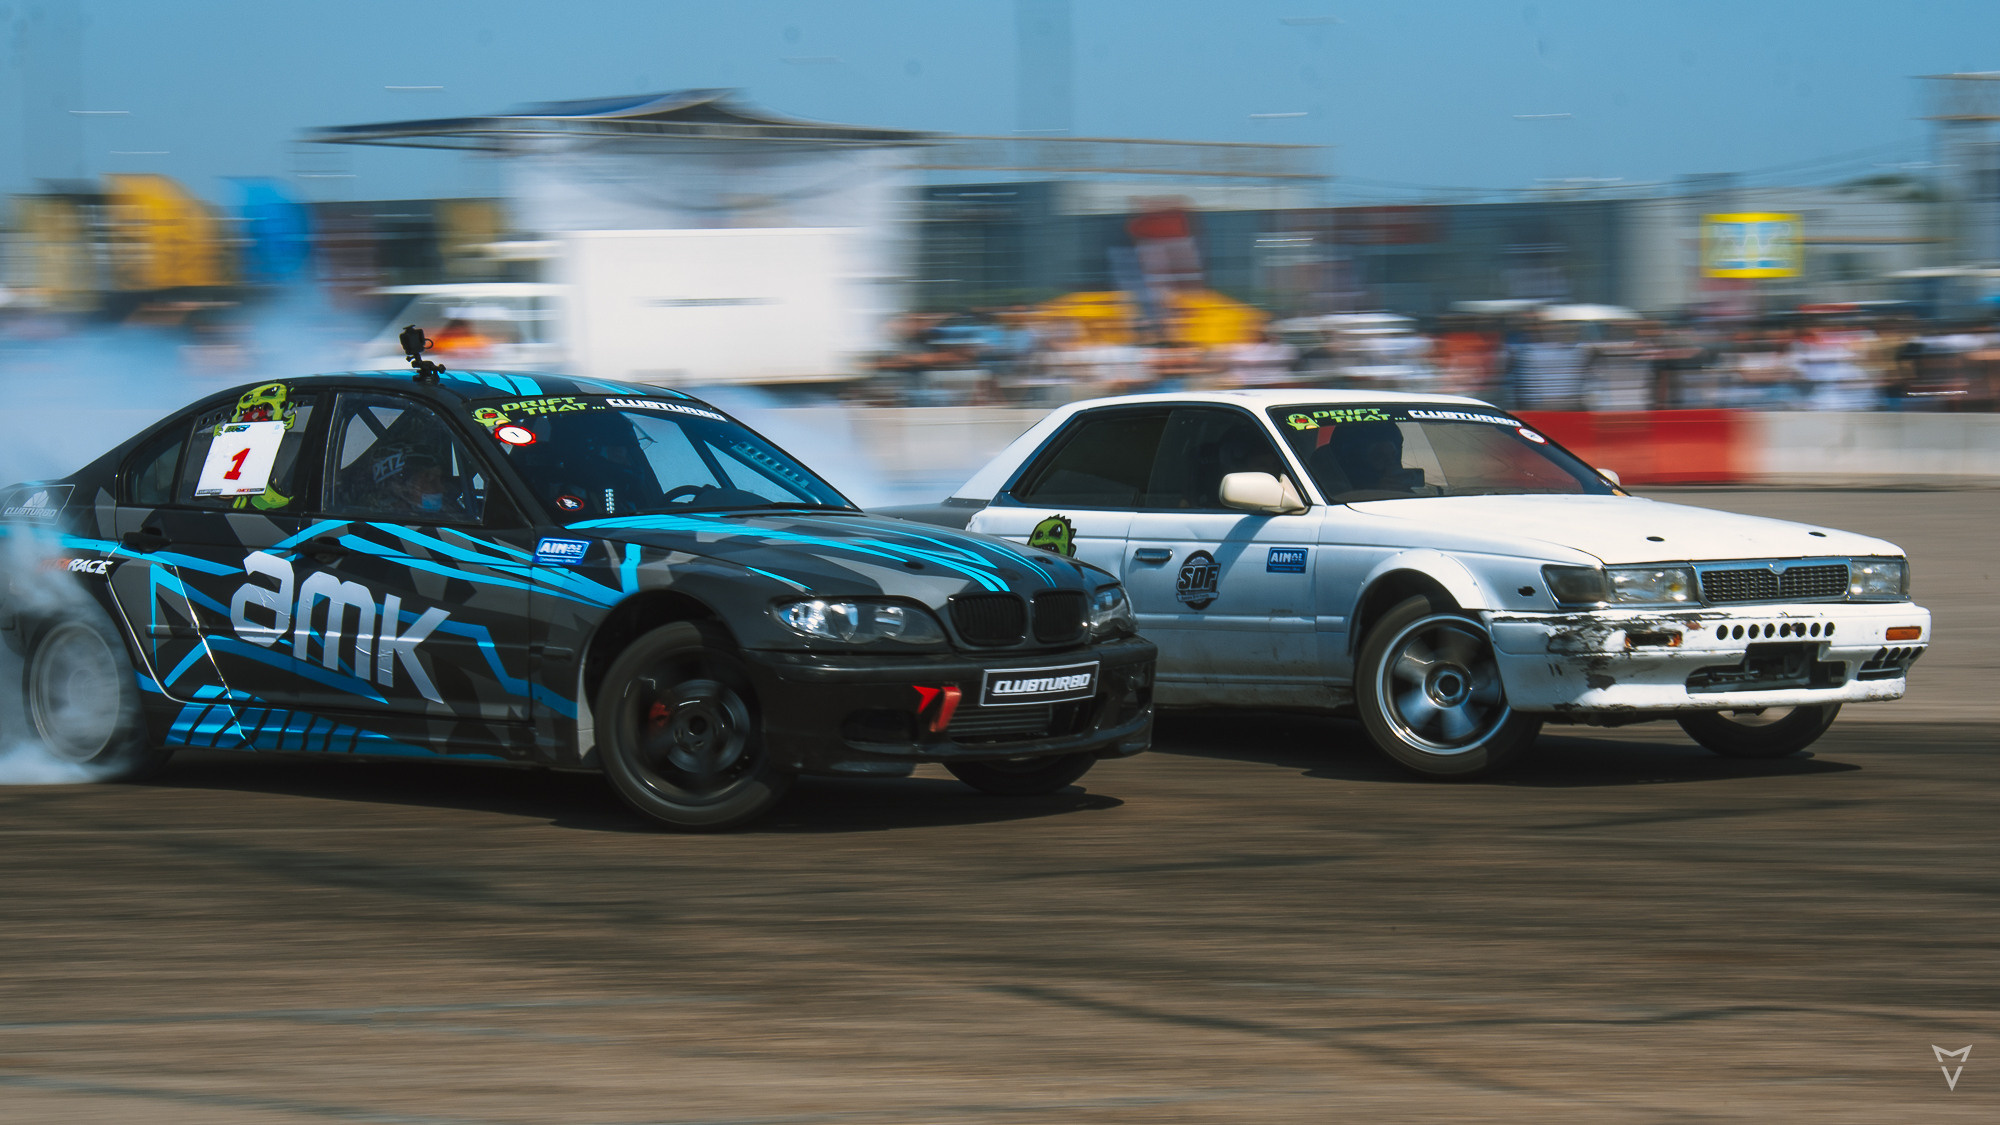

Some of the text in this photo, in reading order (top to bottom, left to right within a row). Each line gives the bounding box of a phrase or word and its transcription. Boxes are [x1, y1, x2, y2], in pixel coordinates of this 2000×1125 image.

[501, 397, 576, 412] DRIFT
[605, 398, 728, 422] CLUBTURBO
[1312, 408, 1381, 419] DRIFT
[1407, 409, 1523, 428] CLUBTURBO
[223, 447, 251, 481] 1
[3, 506, 58, 517] CLUBTURBO
[1177, 565, 1221, 591] SDF
[230, 550, 451, 704] amk
[992, 673, 1092, 694] CLUBTURBO
